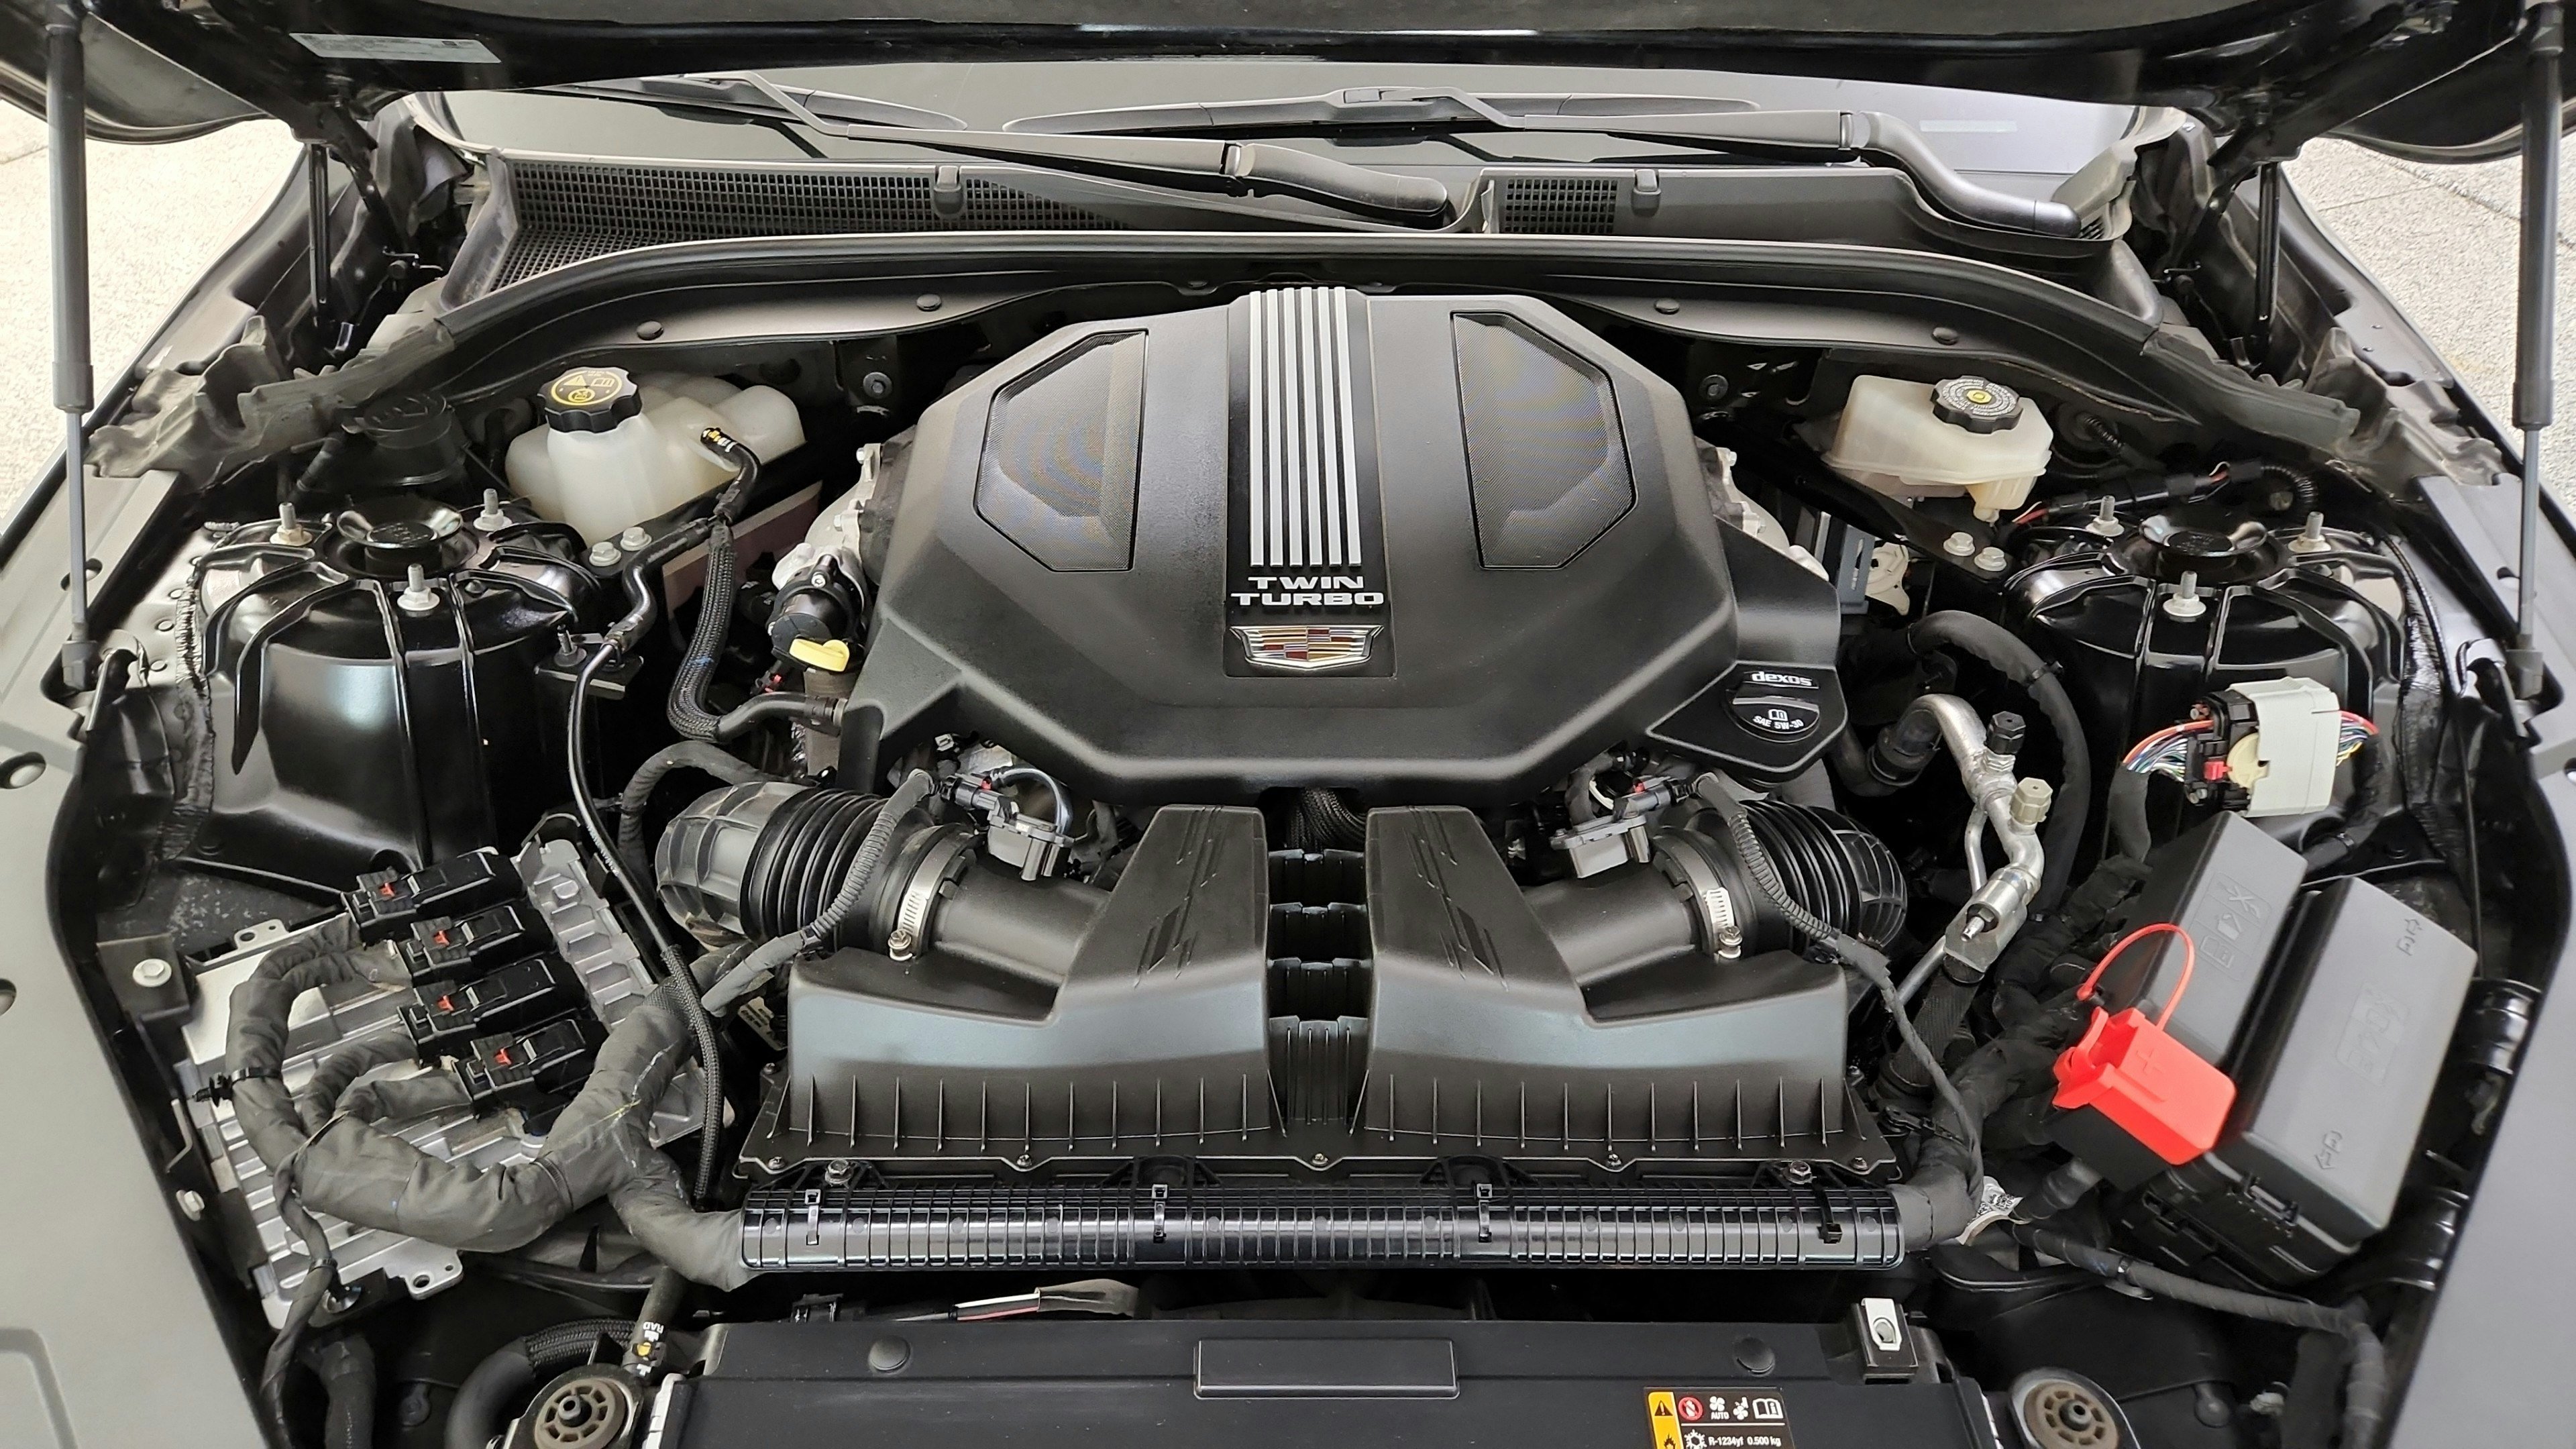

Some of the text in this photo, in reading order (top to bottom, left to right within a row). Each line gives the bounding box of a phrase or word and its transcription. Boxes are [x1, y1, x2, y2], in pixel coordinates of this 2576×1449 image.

[1248, 576, 1364, 589] TWIN
[1230, 592, 1384, 606] TURBO
[1750, 672, 1812, 686] dexos
[1753, 715, 1804, 730] SAE 5W-30
[643, 1322, 664, 1334] RAD
[1711, 1411, 1729, 1420] AUTO
[1708, 1436, 1782, 1447] R-1234yf 0.500 kg
